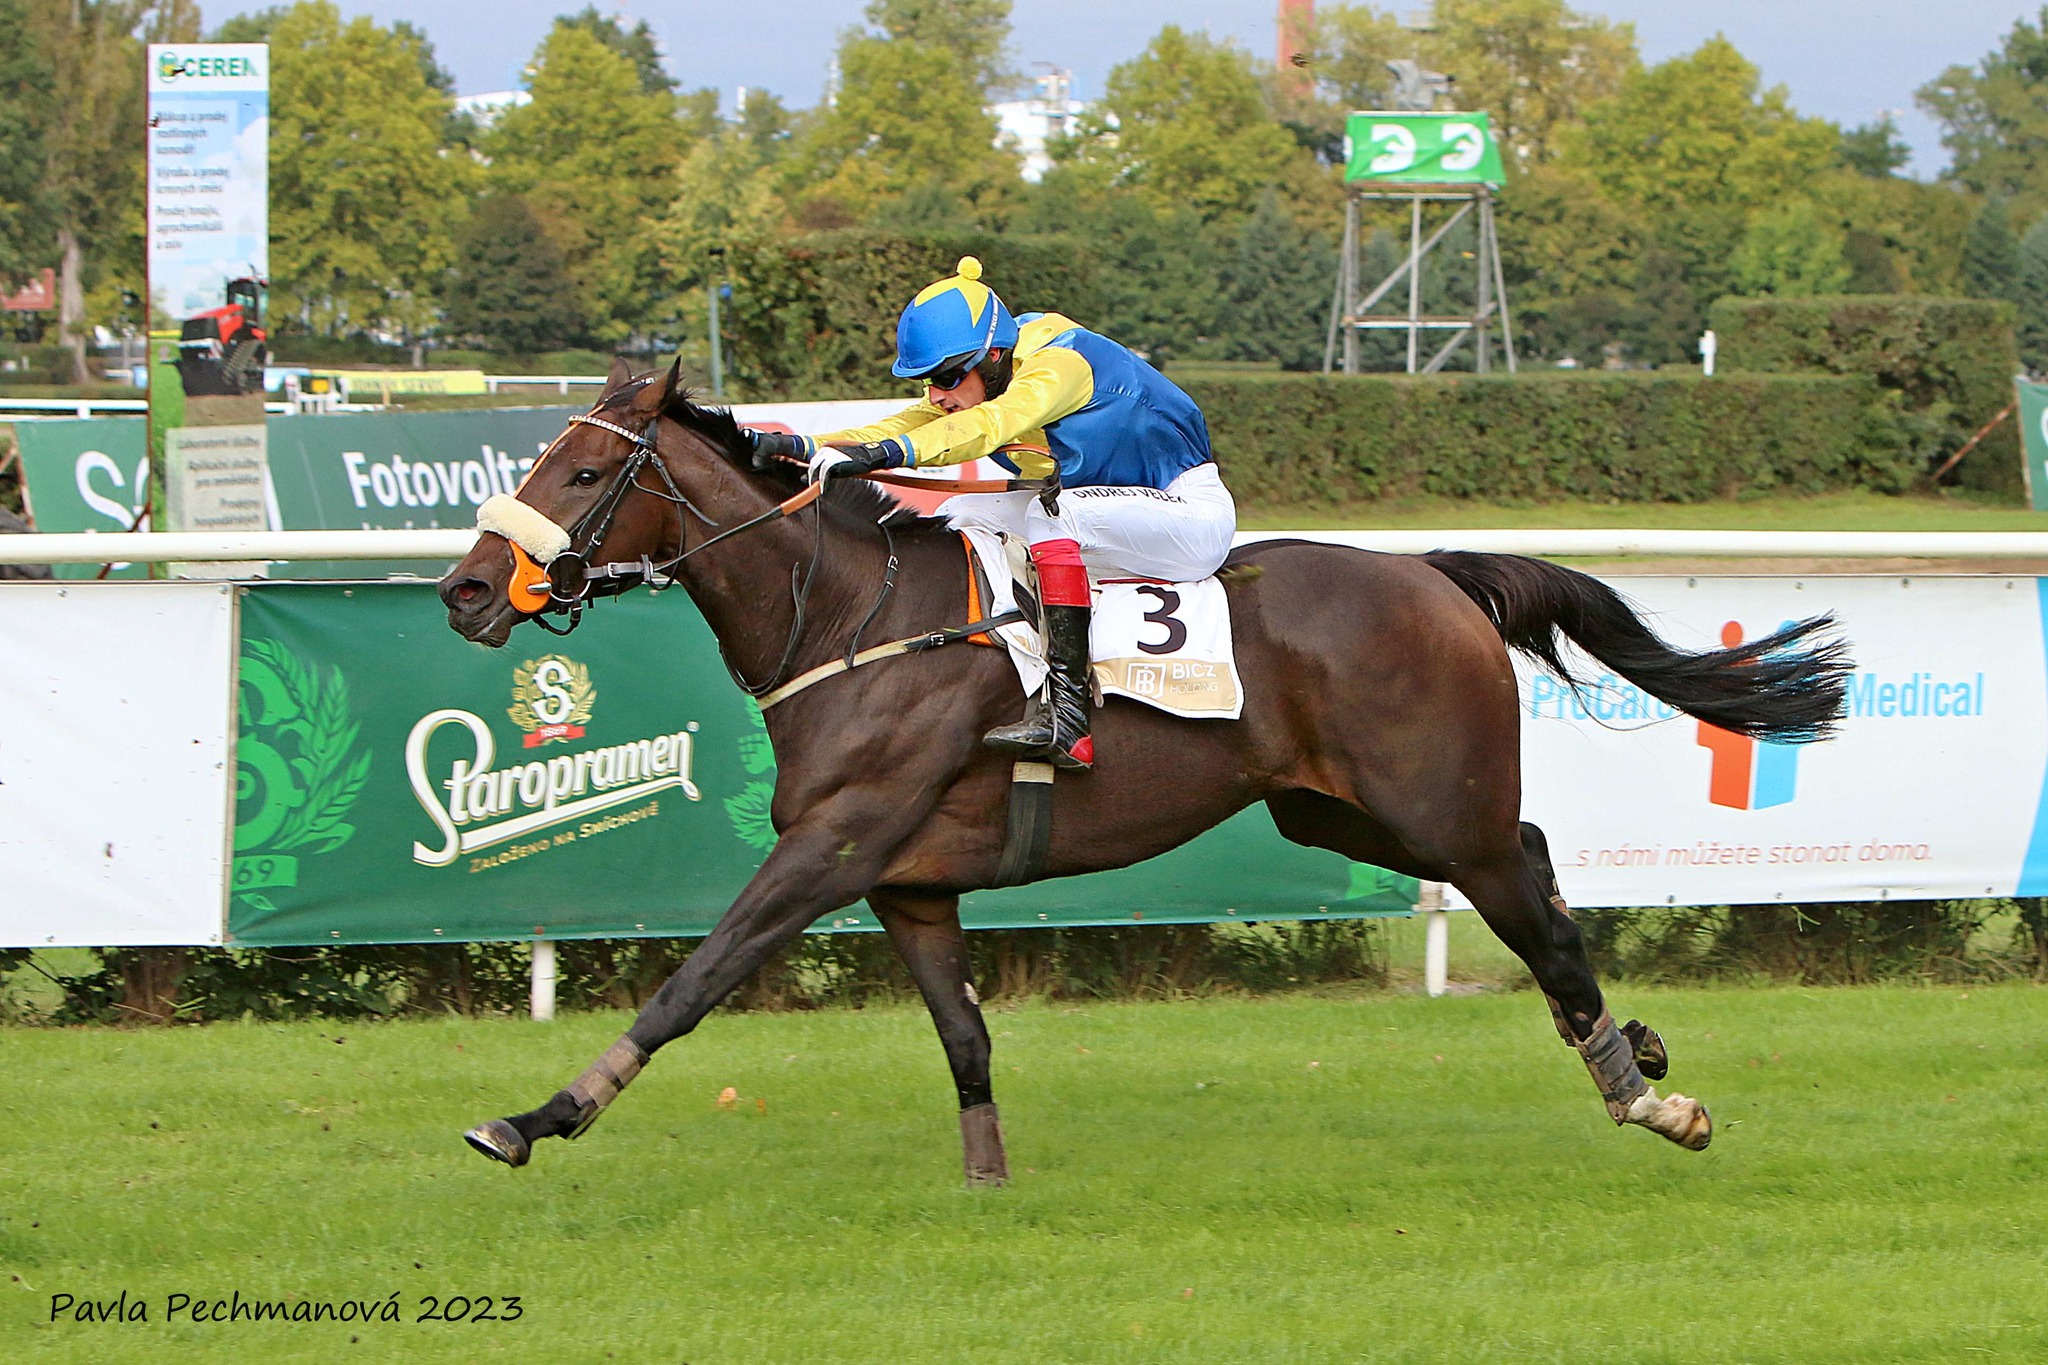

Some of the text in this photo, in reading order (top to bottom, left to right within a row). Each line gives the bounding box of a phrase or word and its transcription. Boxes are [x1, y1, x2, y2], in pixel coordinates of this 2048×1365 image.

[184, 57, 258, 76] CEREA
[342, 443, 548, 508] Fotovolta
[1136, 585, 1187, 655] 3
[1169, 682, 1218, 694] HOLDING
[1845, 672, 1984, 717] Medical
[405, 708, 700, 867] Staropramen
[553, 831, 577, 847] NA
[1595, 842, 1662, 866] námi
[1664, 840, 1762, 865] můžete
[1767, 841, 1852, 864] stonat
